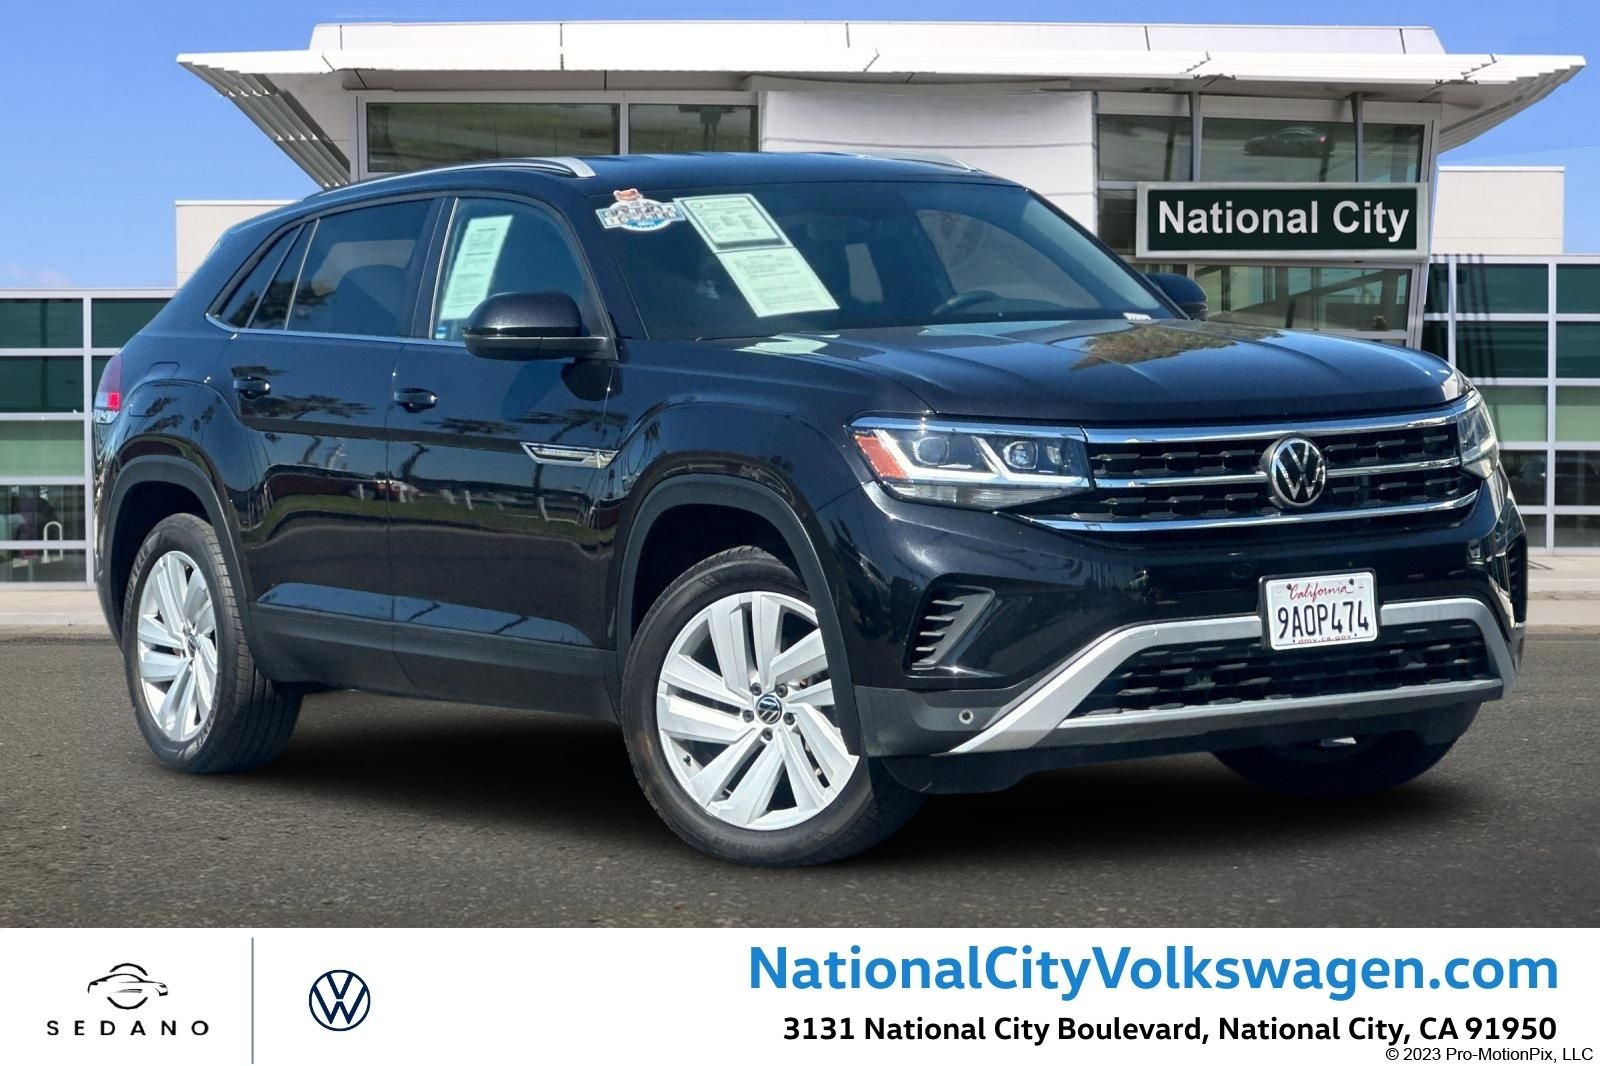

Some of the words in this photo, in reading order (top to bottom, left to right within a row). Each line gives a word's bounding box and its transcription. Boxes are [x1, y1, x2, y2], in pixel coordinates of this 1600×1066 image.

[1159, 200, 1318, 234] National
[1333, 200, 1410, 243] City
[1289, 583, 1353, 602] California
[1277, 600, 1369, 639] 9AOP474
